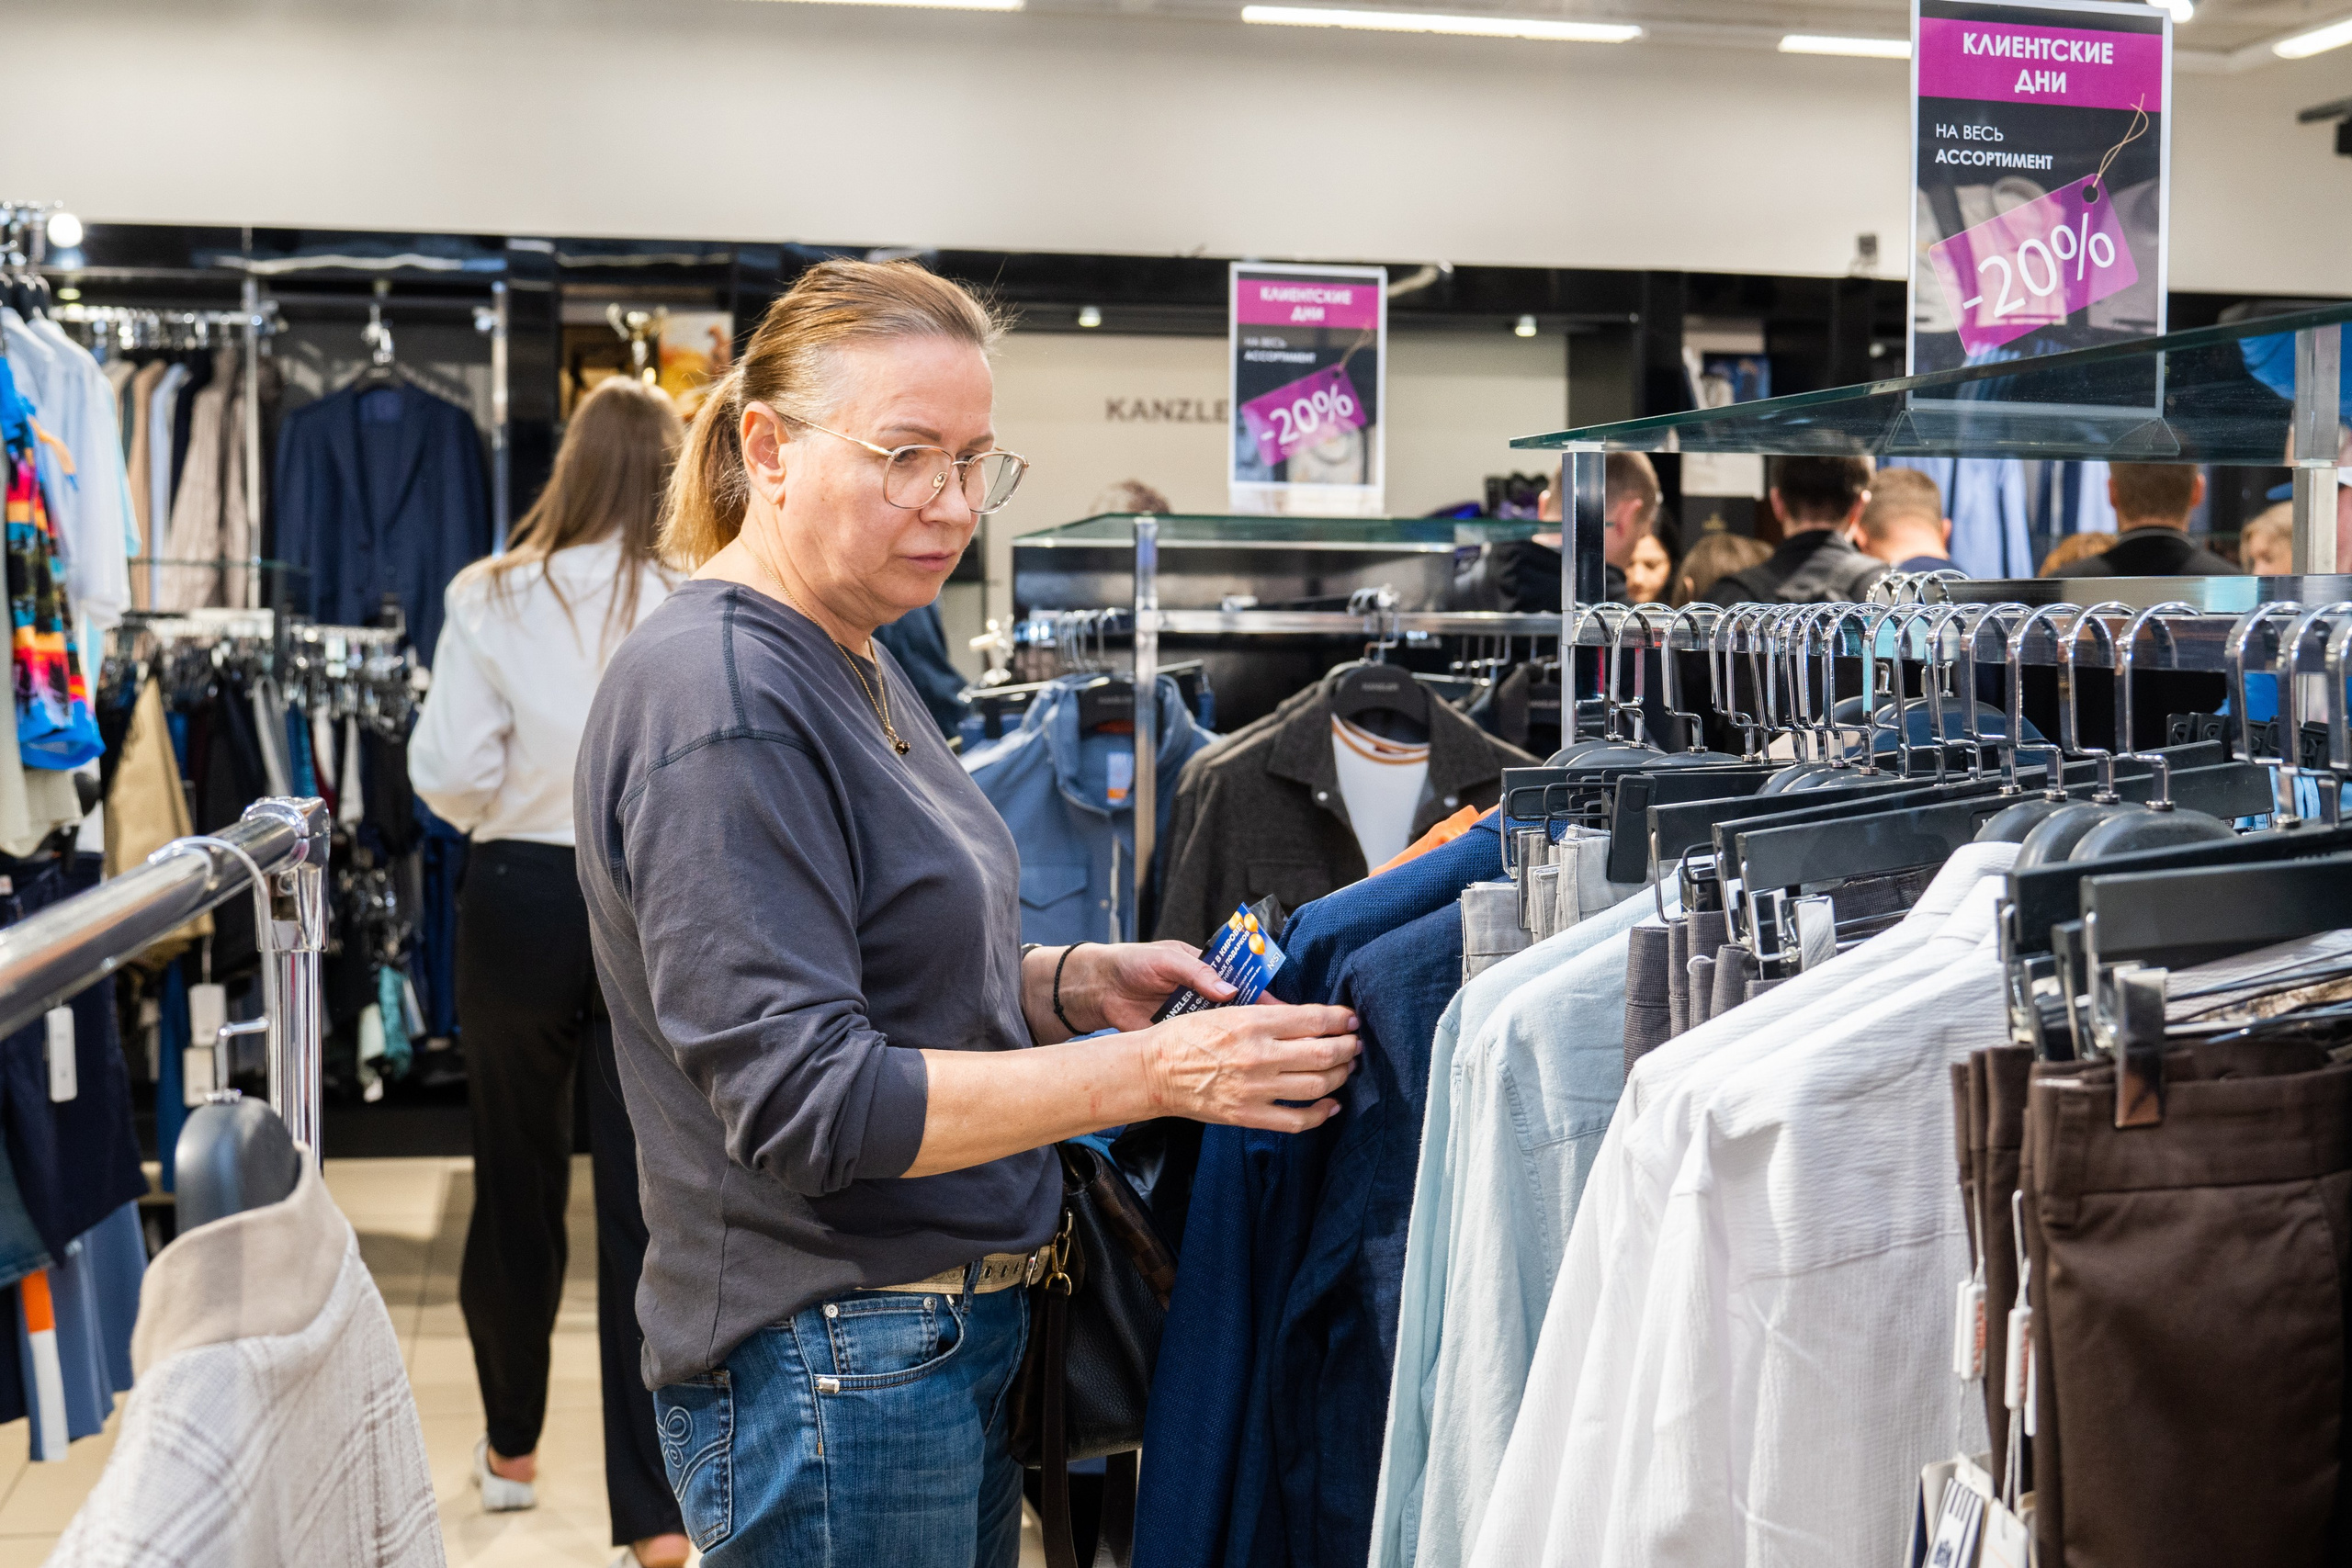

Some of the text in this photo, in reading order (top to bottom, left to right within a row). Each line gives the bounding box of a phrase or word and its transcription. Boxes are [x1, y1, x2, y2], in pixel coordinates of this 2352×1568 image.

[1962, 32, 2113, 64] КЛИЕНТСКИЕ
[2014, 69, 2066, 95] ДНИ
[1936, 123, 2004, 142] НА ВЕСЬ
[1935, 149, 2053, 171] АССОРТИМЕНТ
[1962, 212, 2116, 318] -20%
[1260, 287, 1352, 305] КЛИЕНТСКИЕ
[1290, 306, 1326, 322] ДНИ
[1104, 398, 1229, 423] KANZLE
[1260, 384, 1354, 446] -20%
[1225, 930, 1250, 965] ПОДАРКОВ
